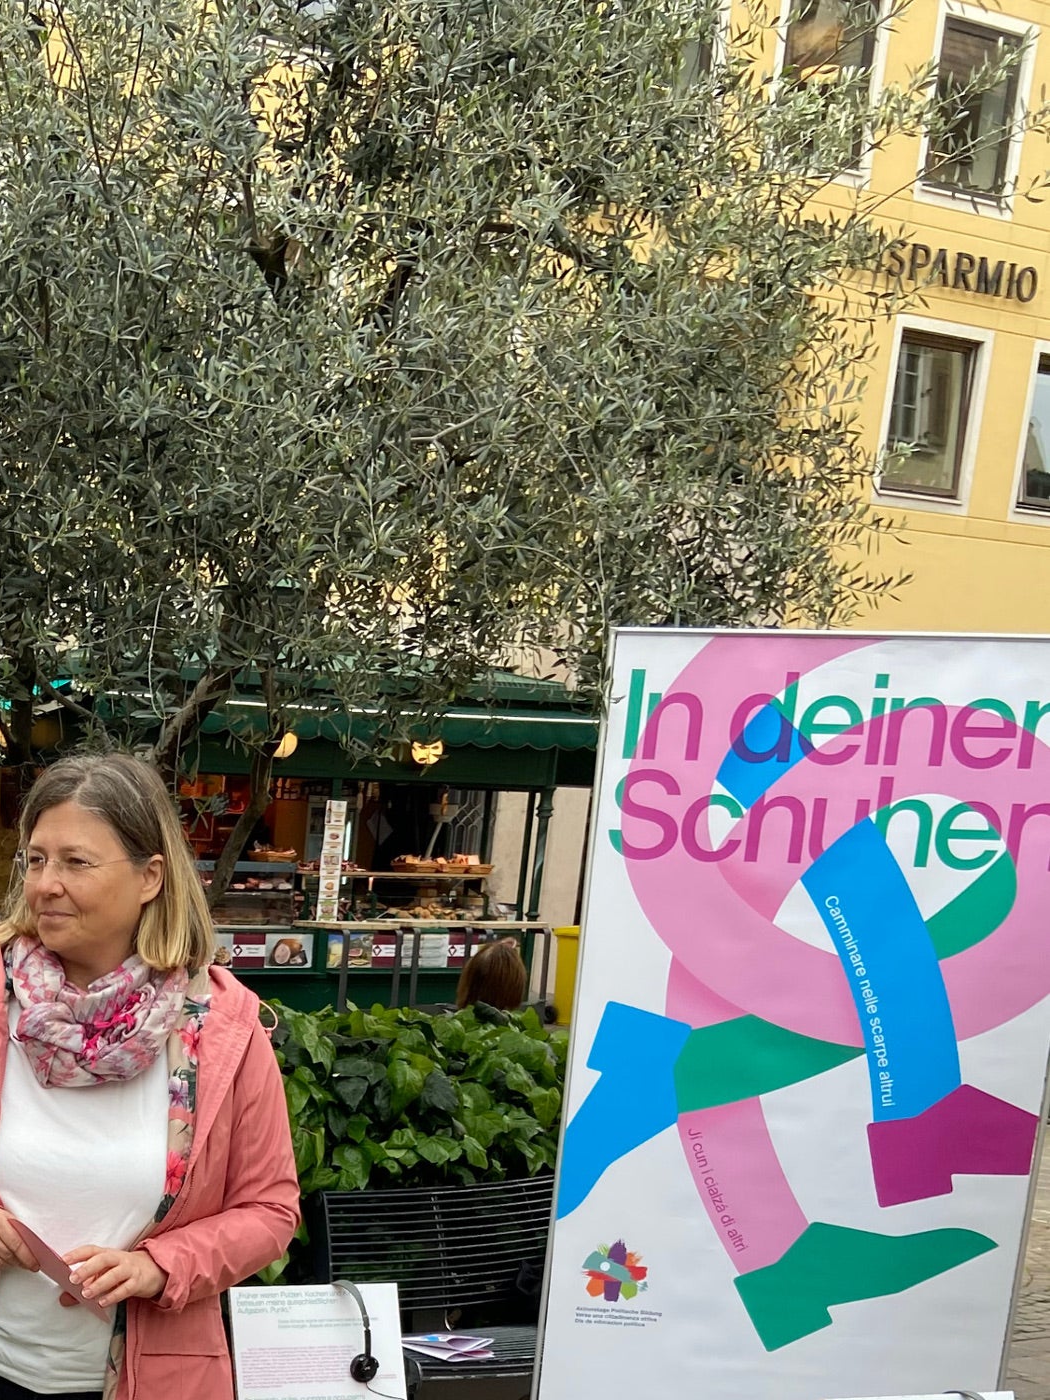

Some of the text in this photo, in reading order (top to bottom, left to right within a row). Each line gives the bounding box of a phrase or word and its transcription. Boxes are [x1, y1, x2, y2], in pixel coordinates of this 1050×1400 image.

[622, 669, 703, 761] In
[825, 895, 896, 1107] Camminare nelle scarpe altrui
[693, 1143, 708, 1168] cun
[720, 1214, 736, 1228] di
[727, 1228, 749, 1253] altri
